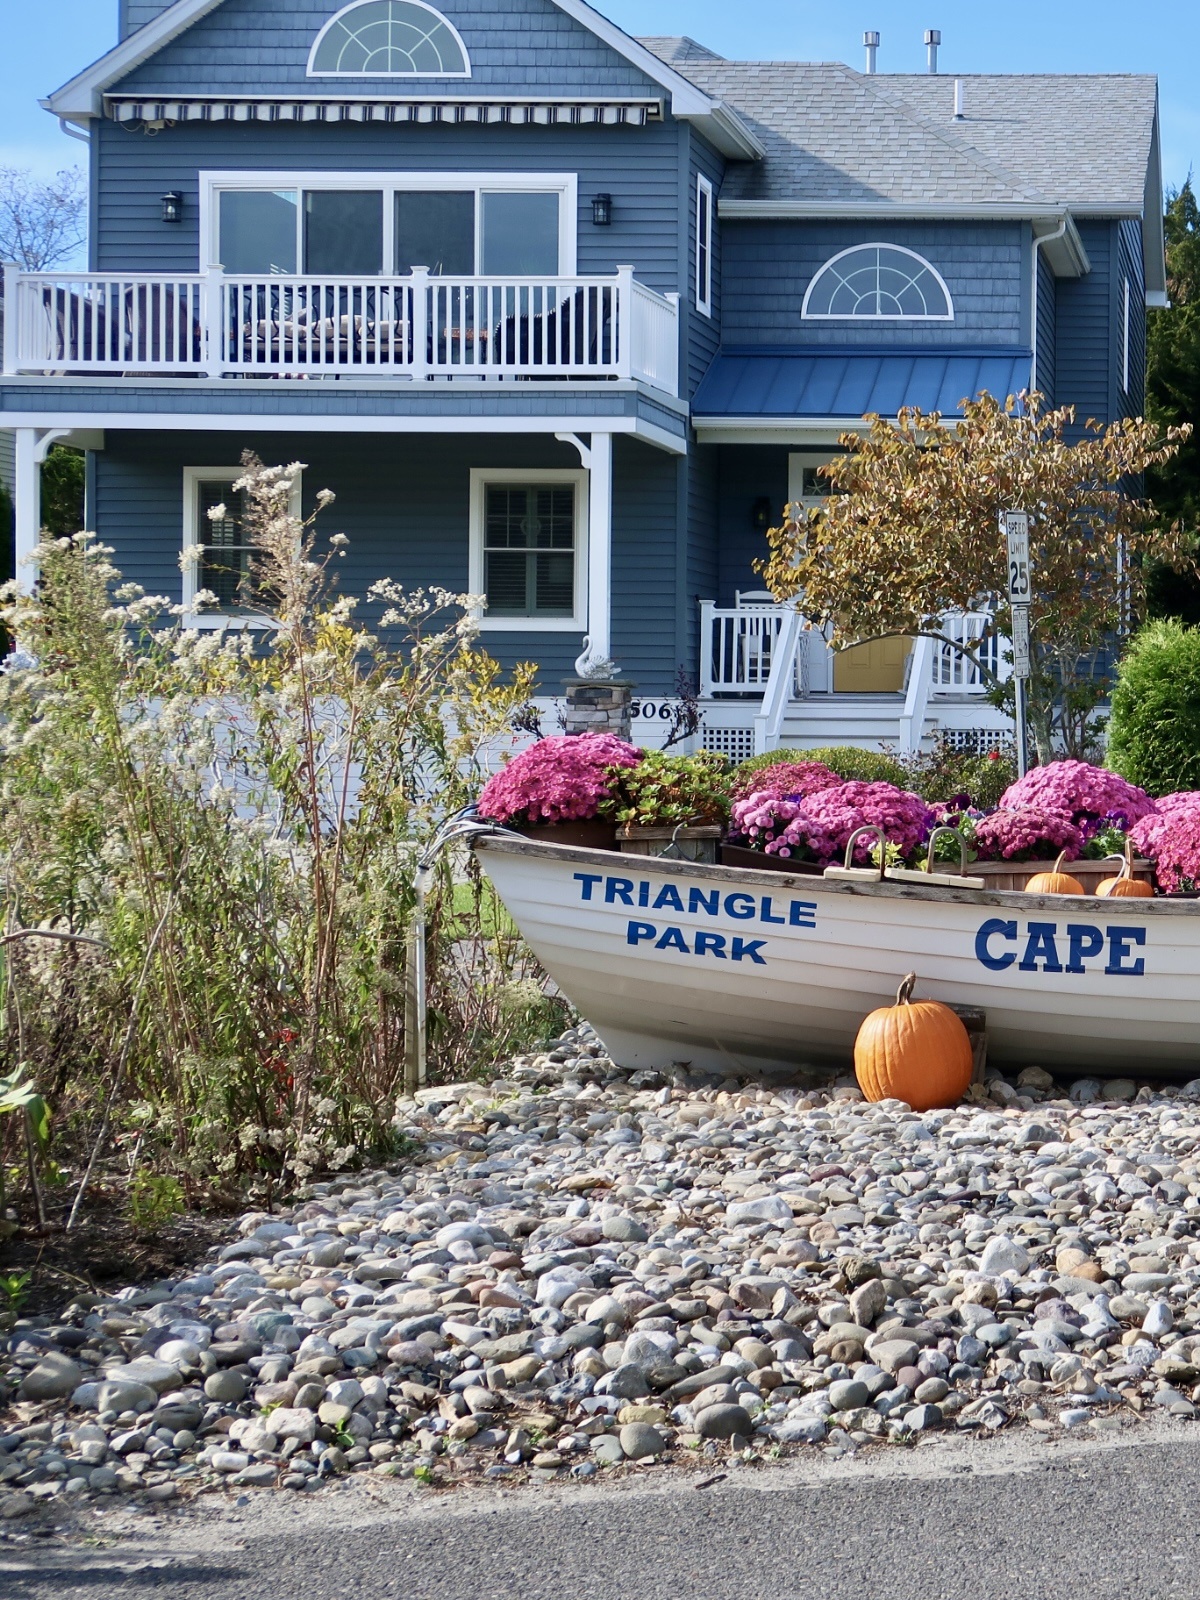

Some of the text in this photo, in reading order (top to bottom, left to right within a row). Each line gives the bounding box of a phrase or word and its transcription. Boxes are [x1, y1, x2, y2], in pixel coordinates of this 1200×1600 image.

[1008, 521, 1025, 534] SPEED
[1010, 542, 1025, 555] LIMIT
[1010, 561, 1028, 595] 25
[630, 702, 671, 719] 506
[573, 872, 818, 929] TRIANGLE
[627, 920, 769, 966] PARK
[975, 918, 1147, 976] CAPE
